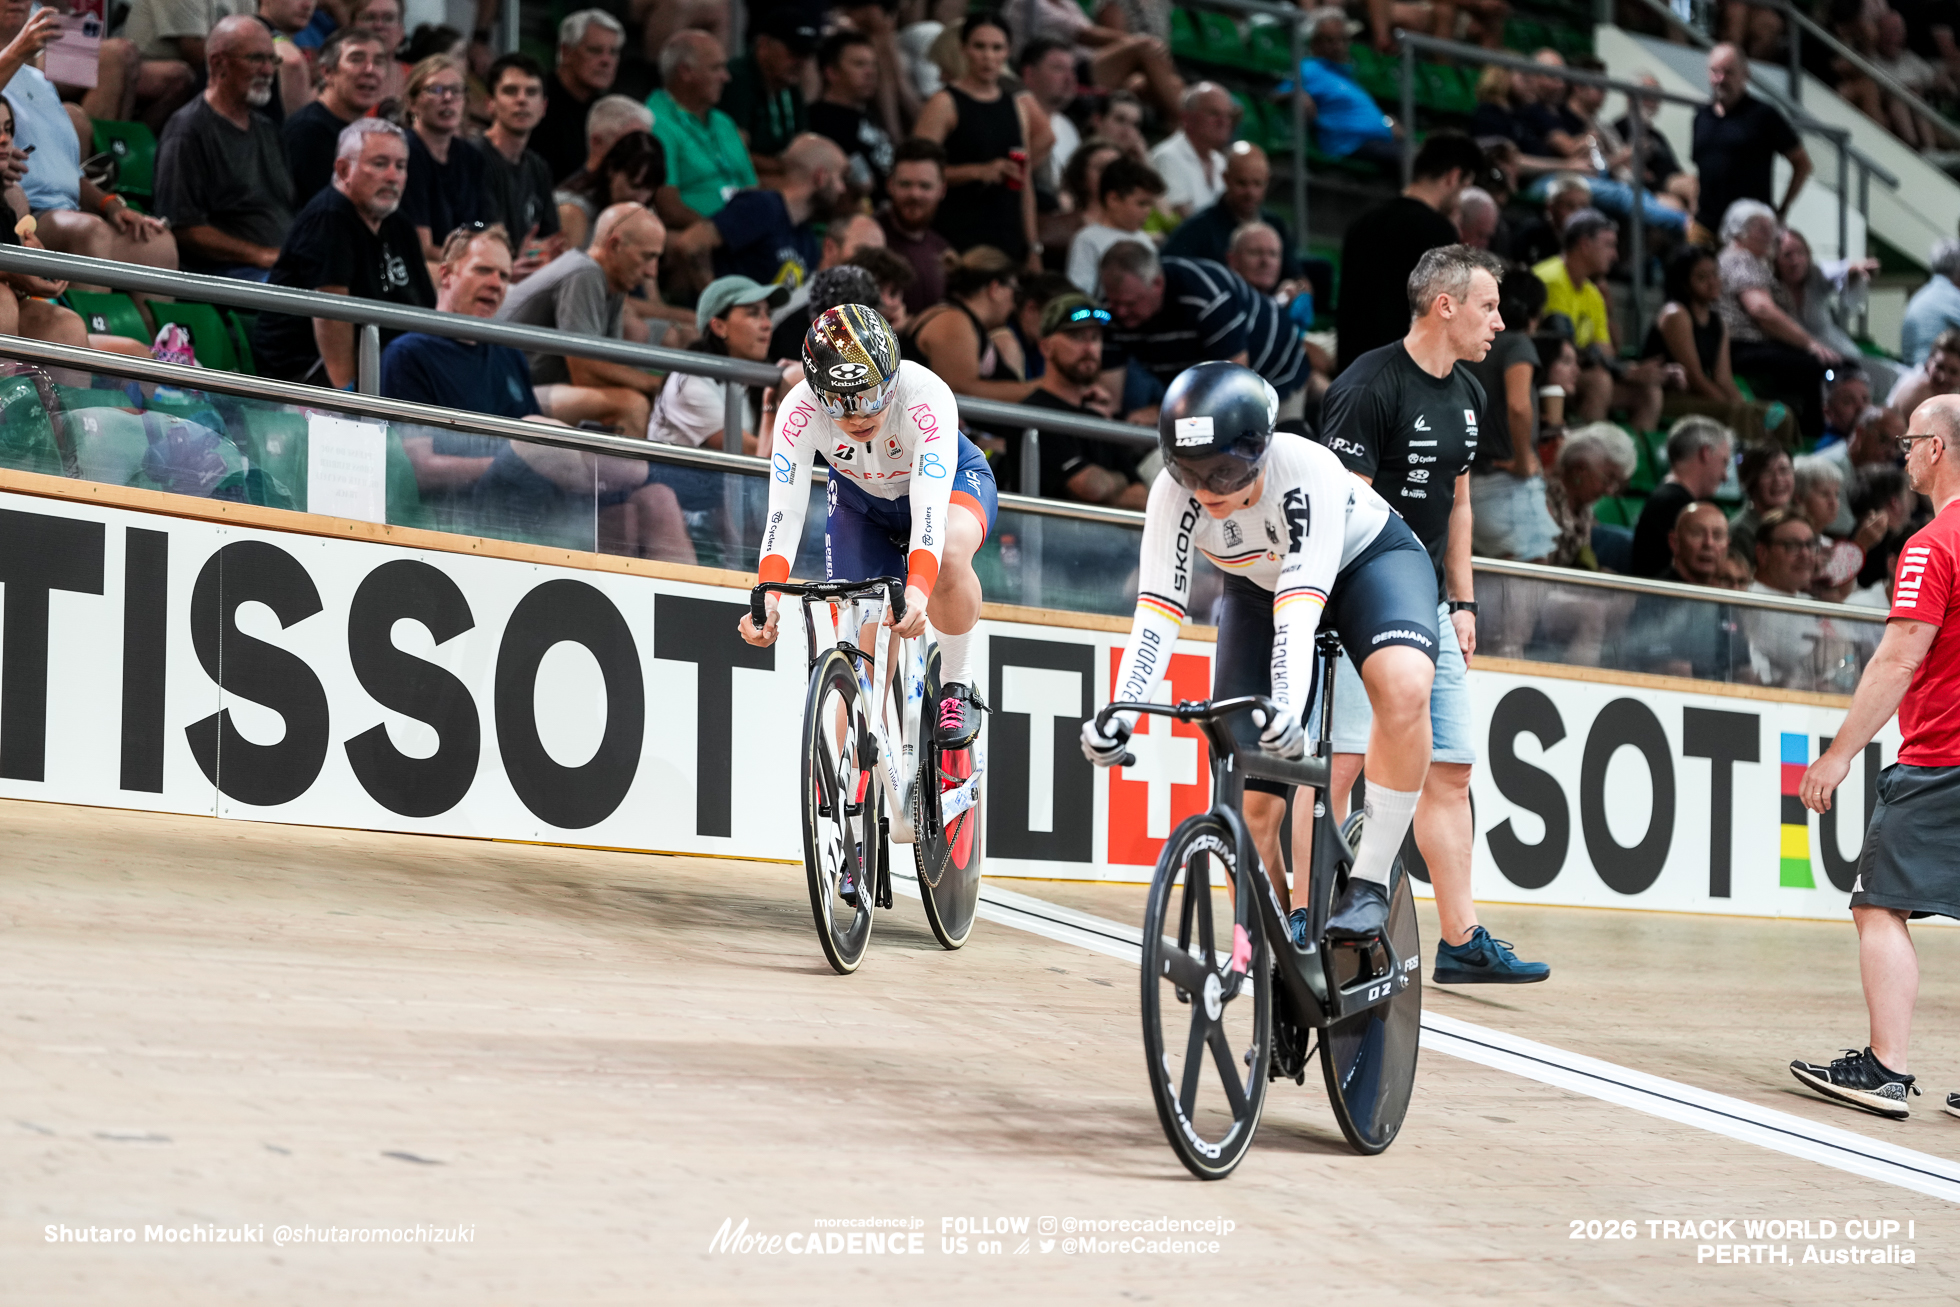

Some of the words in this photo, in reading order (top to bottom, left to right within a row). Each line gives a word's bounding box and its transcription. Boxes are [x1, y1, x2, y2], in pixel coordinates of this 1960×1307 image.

[831, 378, 869, 387] Kabuto
[925, 506, 933, 533] Cyclers
[767, 524, 778, 552] Cyclers
[1371, 629, 1433, 648] GERMANY
[1119, 628, 1161, 703] BIORACE
[1181, 834, 1237, 873] CORIM
